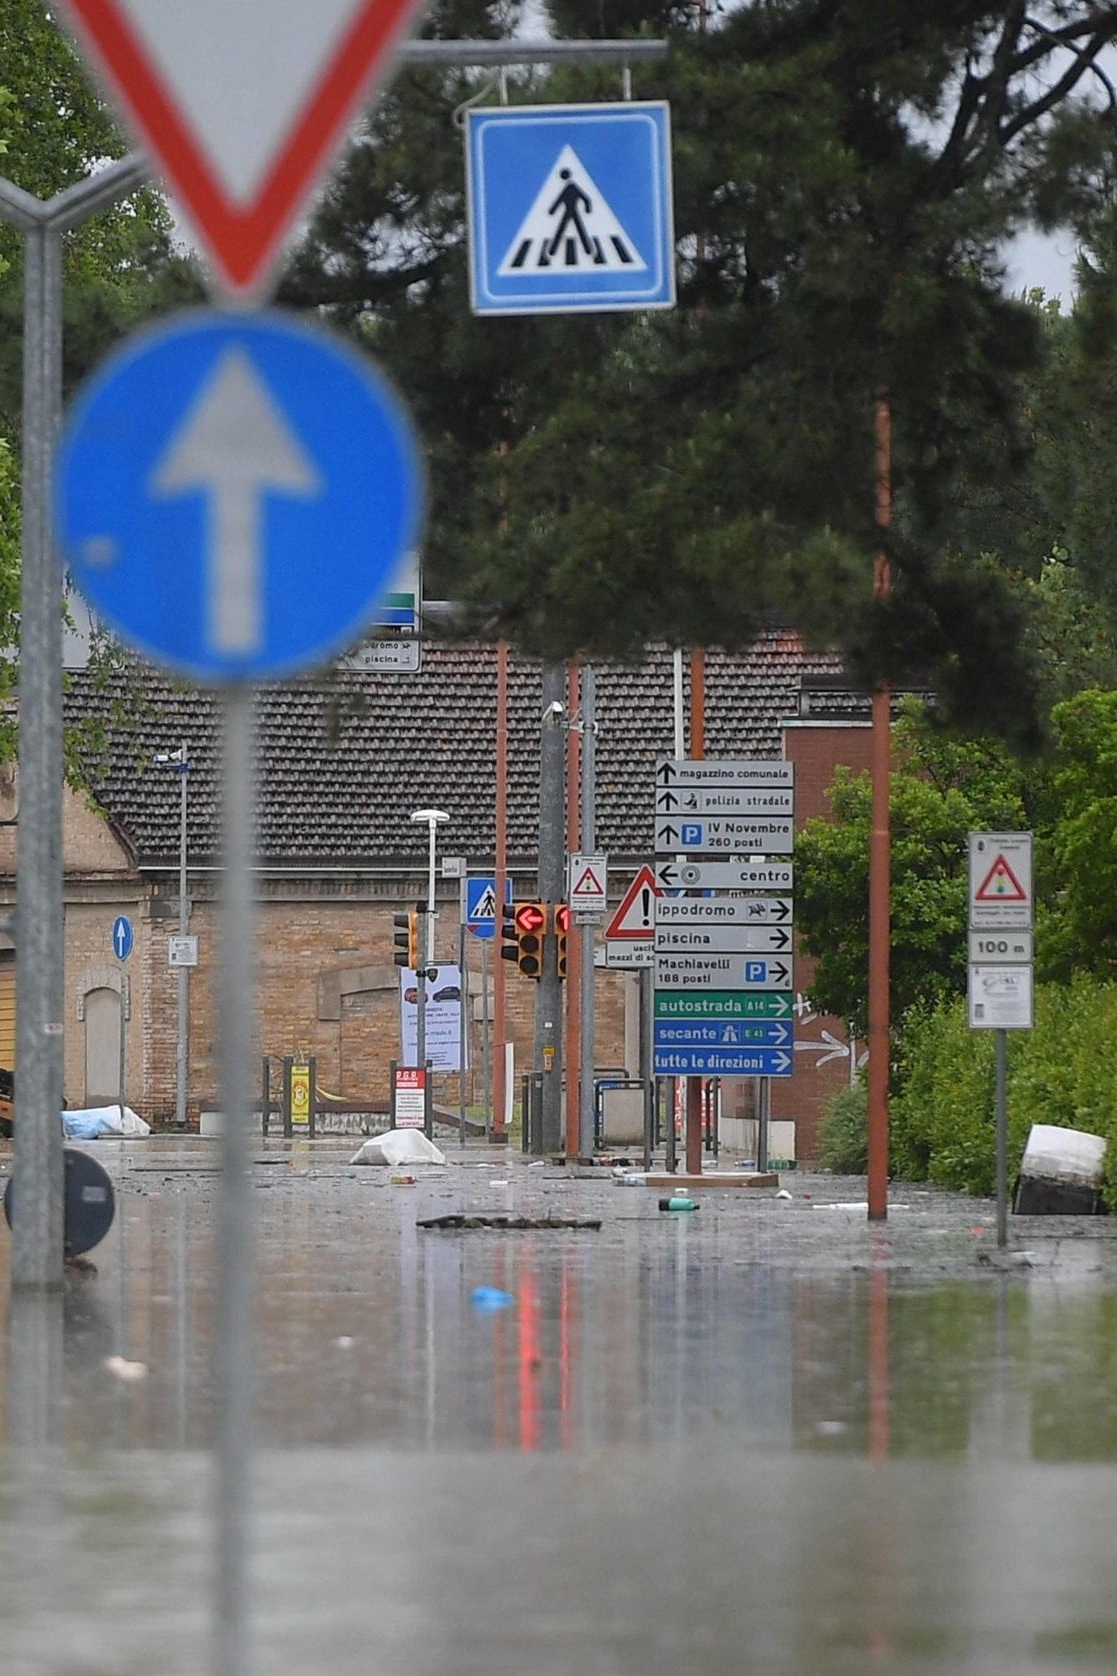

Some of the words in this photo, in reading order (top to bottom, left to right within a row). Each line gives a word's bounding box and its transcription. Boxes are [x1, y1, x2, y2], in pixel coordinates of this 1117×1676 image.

[365, 655, 398, 664] piscina
[680, 768, 734, 779] magazzino
[737, 769, 789, 779] comunale
[705, 795, 740, 806] polizia
[746, 795, 790, 806] stradale
[708, 823, 720, 833] IV
[725, 822, 790, 833] Novembre
[708, 838, 731, 847] 260
[734, 837, 763, 849] posti
[740, 869, 790, 881] centro
[658, 904, 735, 917] ippodromo
[657, 931, 711, 945] piscina
[633, 944, 655, 952] uscit
[978, 941, 1008, 953] 100
[1013, 945, 1025, 953] m
[658, 958, 730, 969] Machiavelli
[658, 973, 679, 983] 188
[682, 973, 711, 985] posti
[659, 999, 742, 1012] autostrada
[747, 1001, 764, 1011] A14
[659, 1028, 717, 1039] secante
[655, 1056, 688, 1068] tutte
[692, 1055, 704, 1068] le
[707, 1054, 764, 1069] direzioni
